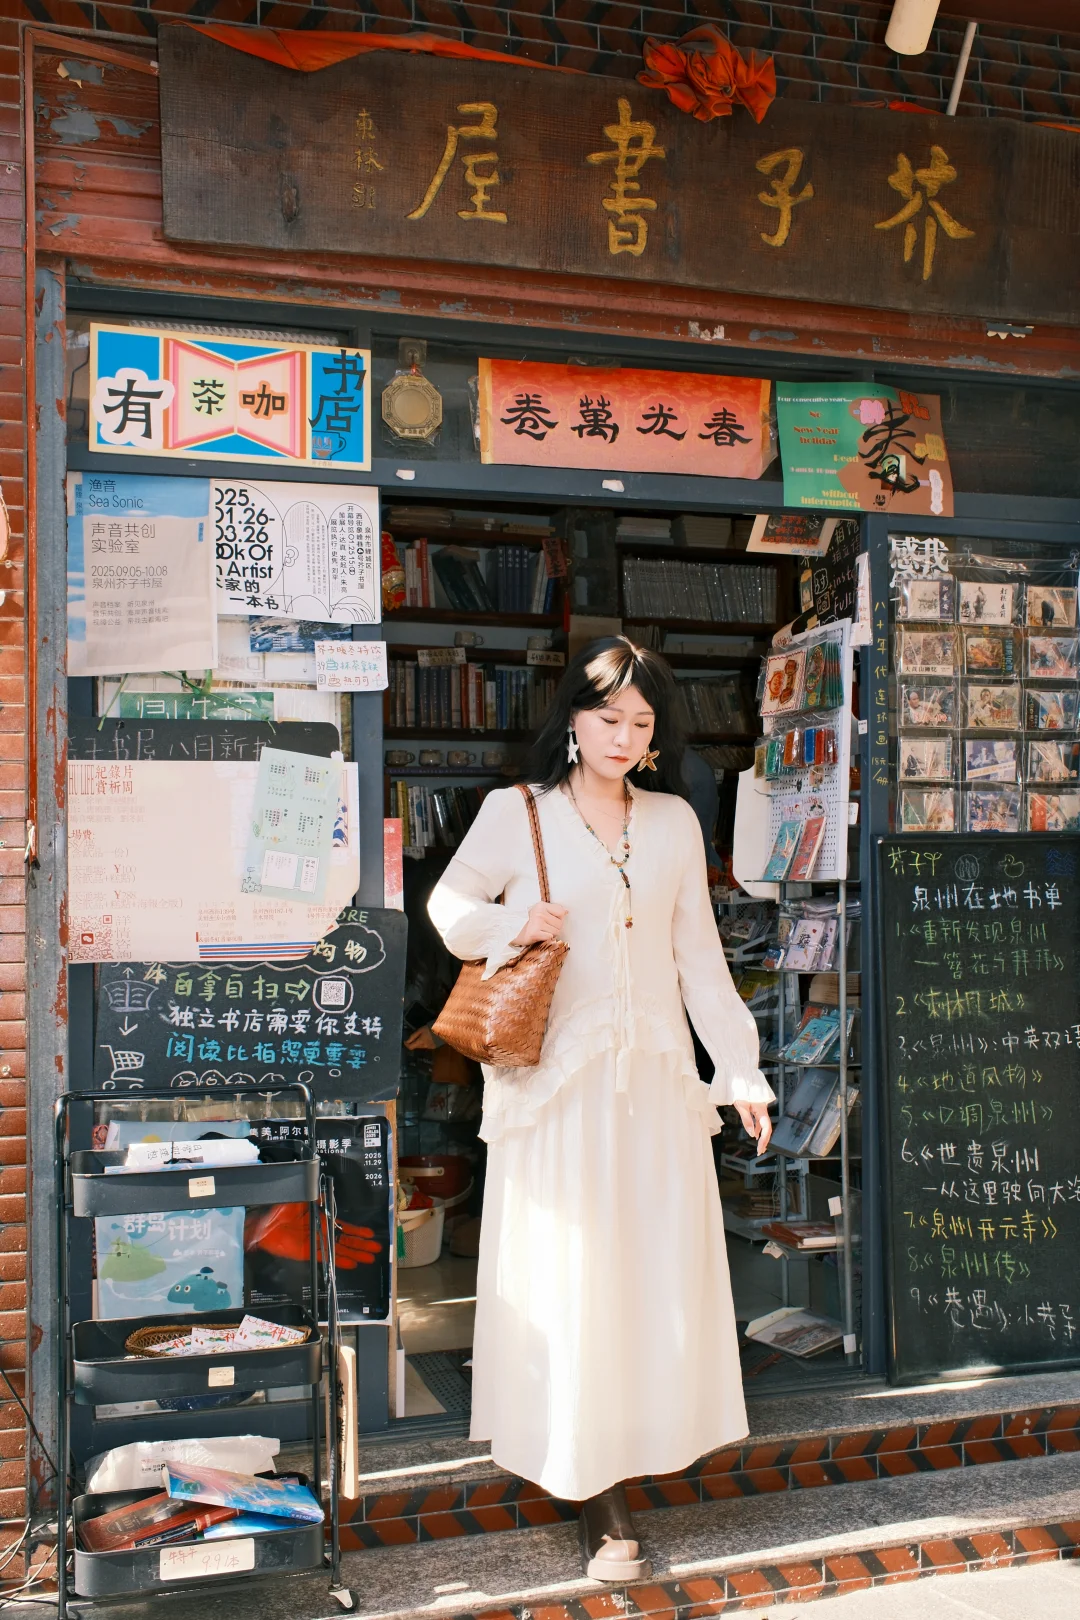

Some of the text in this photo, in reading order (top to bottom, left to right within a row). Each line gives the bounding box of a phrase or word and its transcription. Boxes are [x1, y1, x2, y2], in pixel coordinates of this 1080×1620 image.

[103, 349, 367, 440] 有 茶 咖 书店
[89, 479, 116, 493] 渔音
[89, 494, 144, 509] Sea Sonic
[91, 523, 155, 538] 声音共创
[91, 539, 140, 554] 实验室
[91, 565, 168, 577] 2025.09.05-10.08
[227, 561, 273, 579] Artist
[92, 577, 163, 589] 泉州芥子书屋
[230, 595, 279, 610] 一本书
[343, 675, 370, 686] 热可可
[874, 601, 888, 746] 八十年代连环画
[95, 765, 133, 779] 紀錄片
[95, 781, 133, 795] 賞析周
[911, 881, 1063, 912] 泉州在地书单
[314, 939, 367, 964] 购物
[166, 1033, 367, 1069] 阅读比拍照更重要
